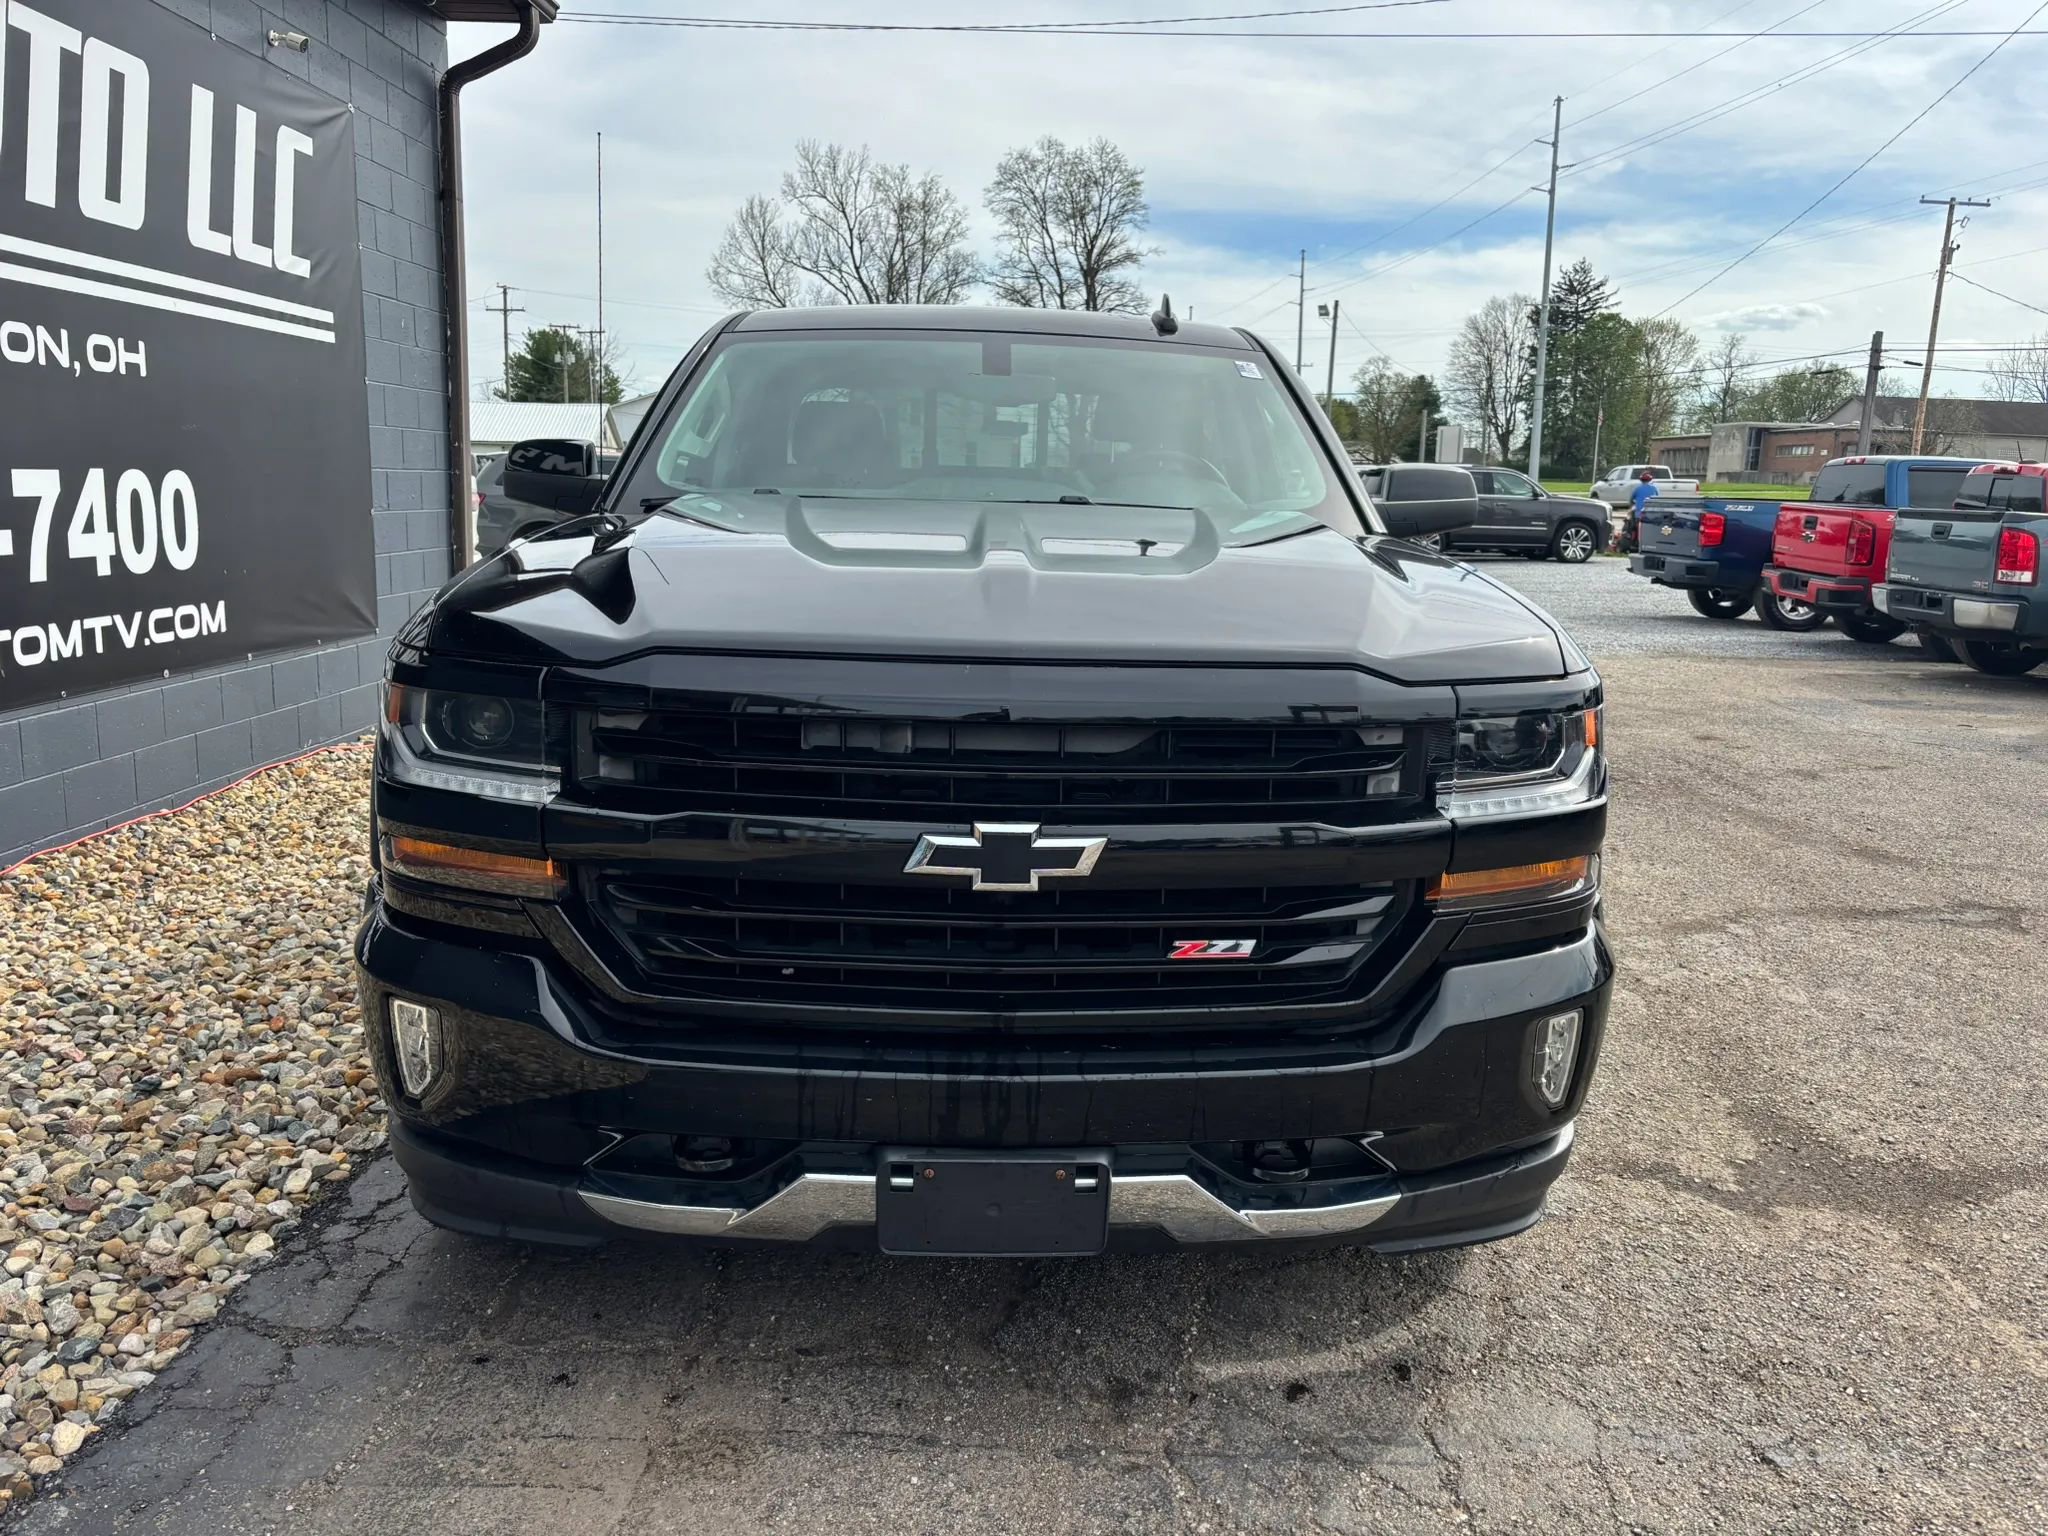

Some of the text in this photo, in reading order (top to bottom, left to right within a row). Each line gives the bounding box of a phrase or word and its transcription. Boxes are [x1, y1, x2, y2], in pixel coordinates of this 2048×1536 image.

[0, 0, 313, 279] TO LLC
[1166, 939, 1257, 959] Z71
